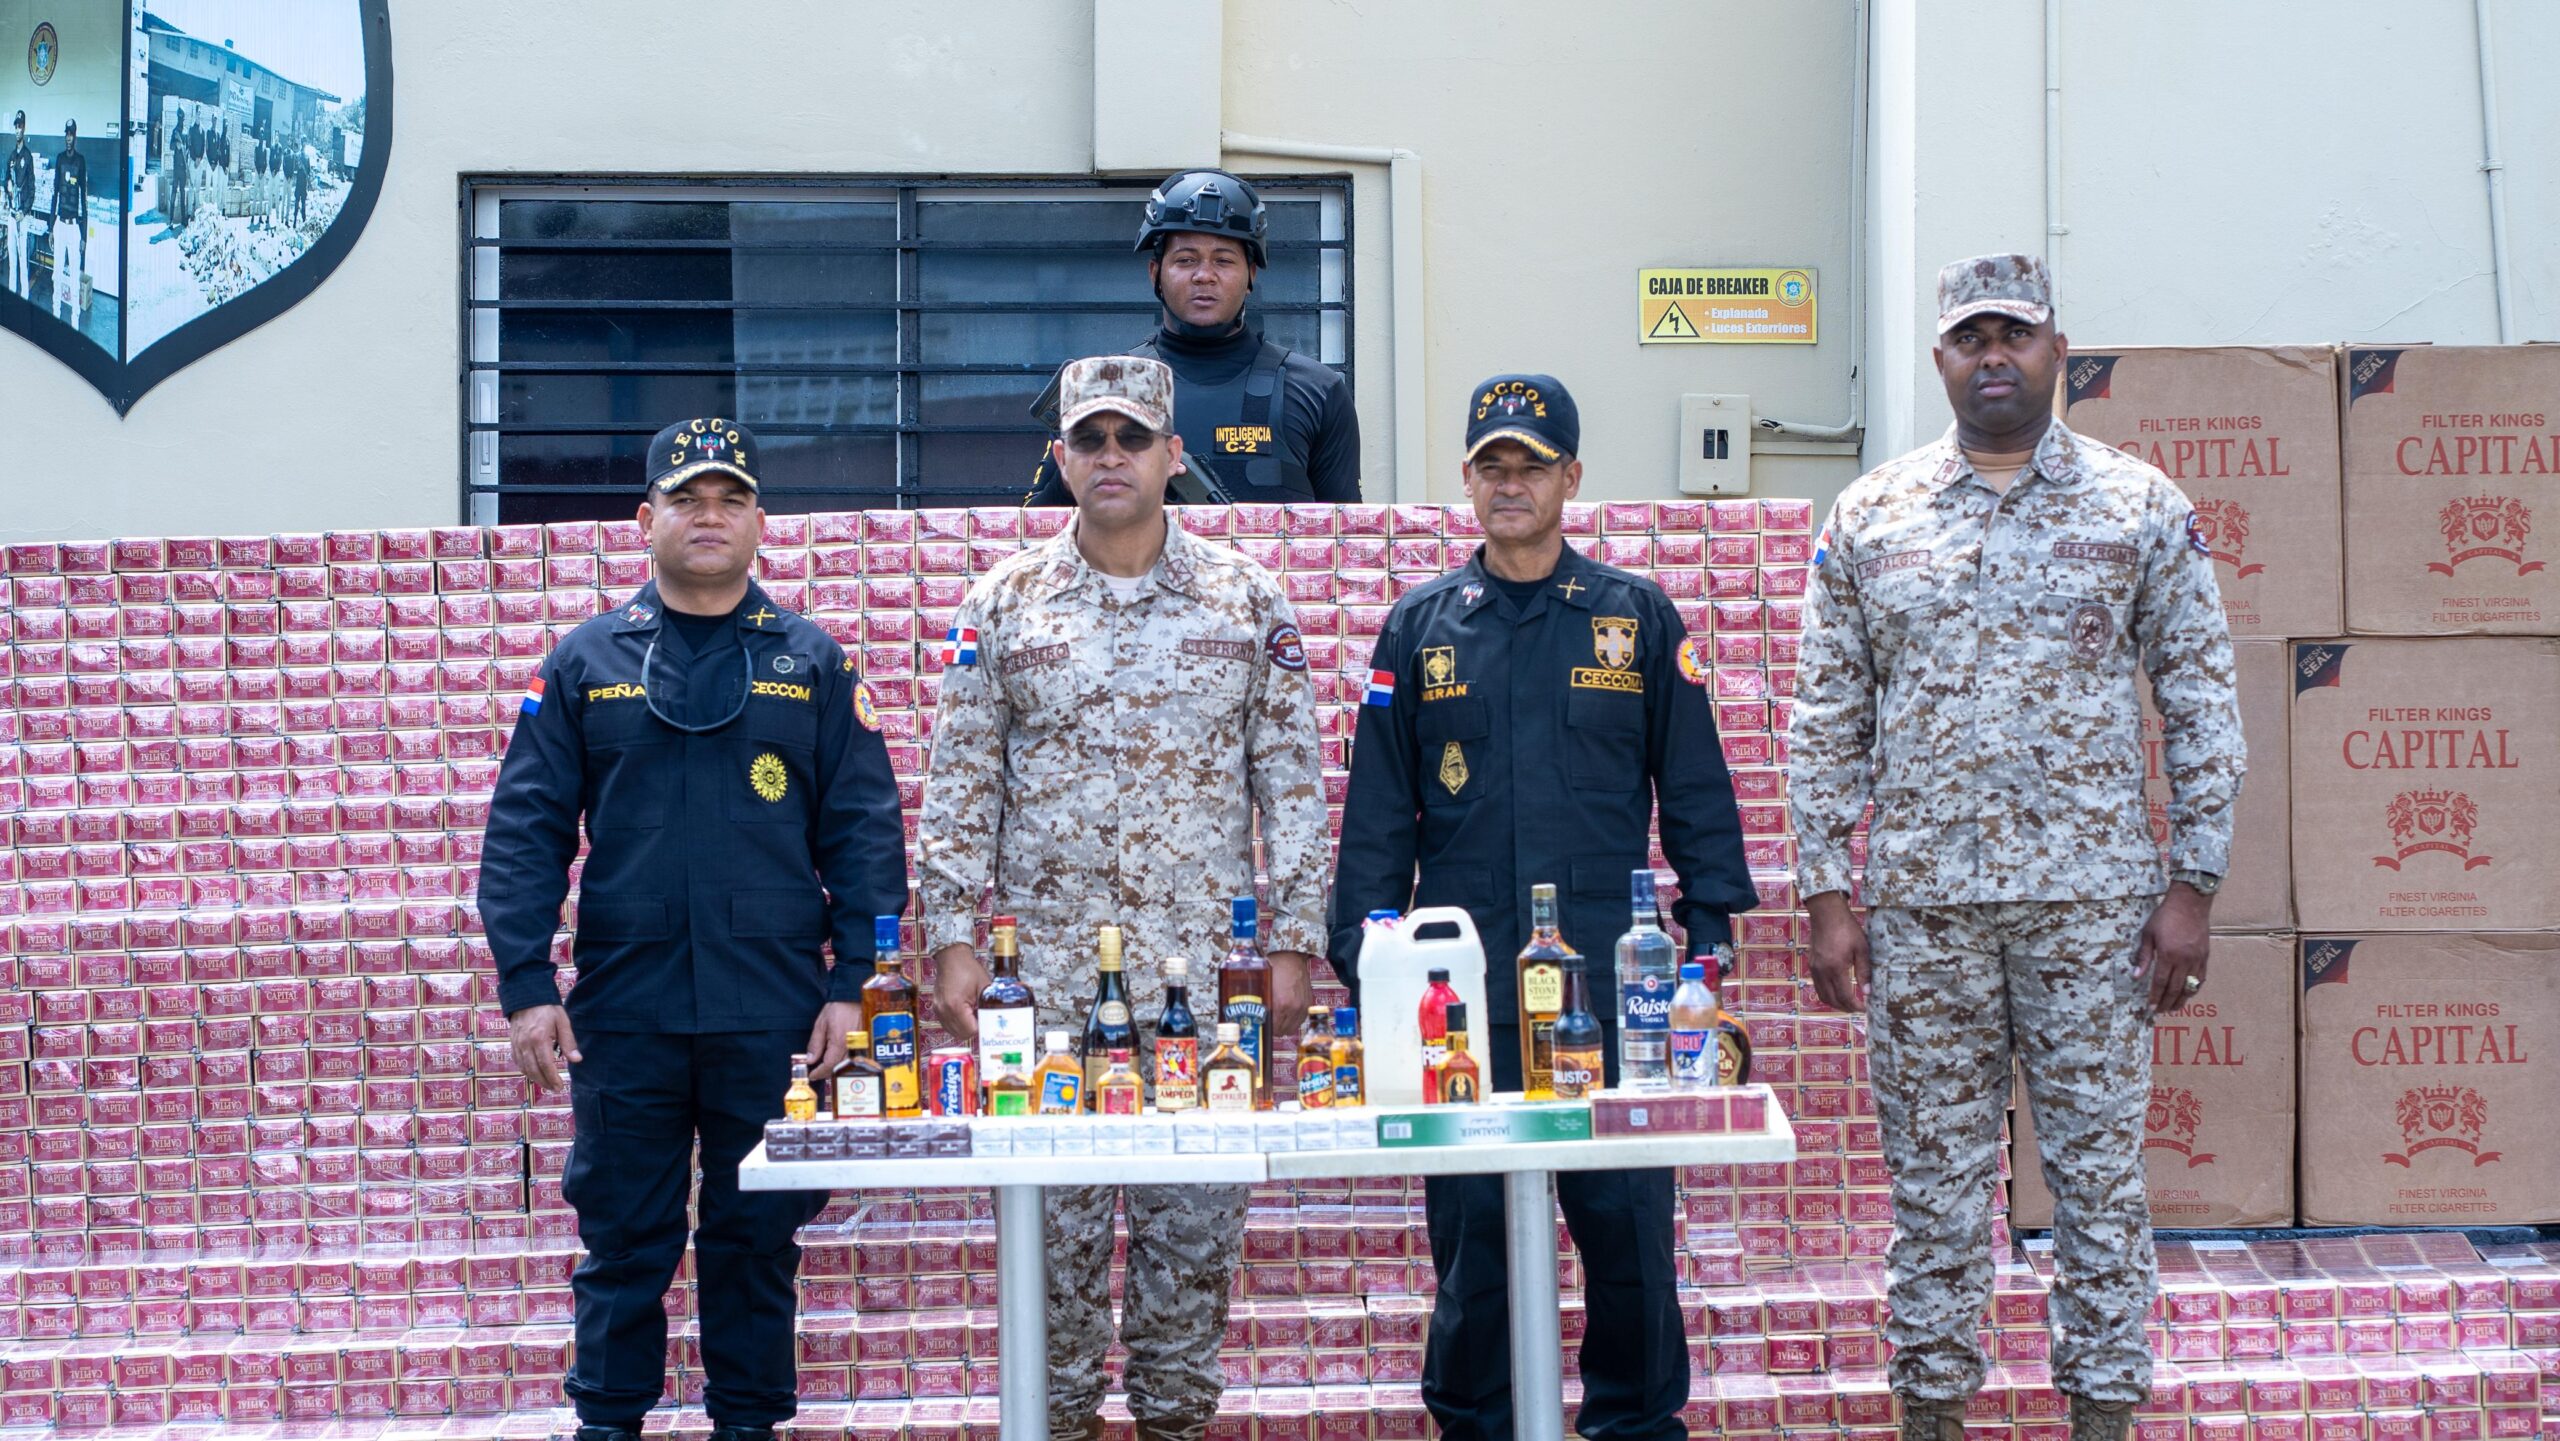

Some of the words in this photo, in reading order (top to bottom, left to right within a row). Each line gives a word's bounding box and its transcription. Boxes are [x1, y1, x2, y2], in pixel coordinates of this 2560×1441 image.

[1649, 277, 1683, 295] CAJA
[1686, 278, 1703, 295] DE
[1706, 277, 1769, 295] BREAKER
[1711, 307, 1768, 320] Explanada
[2352, 351, 2377, 376] FRESH
[2069, 357, 2094, 382] FRESH
[2357, 357, 2387, 385] SEAL
[2074, 362, 2104, 390] SEAL
[1477, 382, 1547, 420] CECCOM
[2139, 418, 2200, 433] FILTER
[2207, 415, 2262, 431] KINGS
[2422, 414, 2483, 428] FILTER
[2490, 413, 2545, 428] KINGS
[1216, 426, 1272, 442] INTELIGENCIA
[671, 418, 746, 468] CECCOM
[1225, 441, 1257, 453] C-2
[1719, 511, 1748, 520] CAPITAL
[283, 544, 312, 553] CAPITAL
[335, 542, 366, 551] CAPITAL
[123, 548, 152, 557] CAPITAL
[176, 551, 206, 560] CAPITAL
[1296, 549, 1325, 558] CAPITAL
[2057, 545, 2137, 564] CESFRONT
[874, 557, 905, 566] CAPITAL
[1865, 553, 1919, 576] HIDALGO
[611, 566, 640, 575] CAPITAL
[1770, 579, 1801, 588] CAPITAL
[1295, 584, 1325, 594] CAPITAL
[2442, 598, 2480, 608] FINEST
[2483, 597, 2532, 608] VIRGINIA
[2432, 612, 2469, 623] FILTER
[2472, 611, 2541, 622] CIGARETTES
[132, 618, 163, 627] CAPITAL
[2298, 645, 2325, 670] FRESH
[2303, 650, 2334, 679] SEAL
[1580, 671, 1640, 689] CECCOM
[589, 682, 647, 702] PEÑA
[751, 681, 811, 702] CECCOM
[874, 690, 904, 700] CAPITAL
[293, 714, 324, 723] CAPITAL
[2368, 708, 2430, 722] FILTER
[2436, 707, 2492, 721] KINGS
[30, 723, 61, 732] CAPITAL
[349, 744, 380, 753] CAPITAL
[455, 740, 486, 749] CAPITAL
[2342, 729, 2519, 770] CAPITAL
[1730, 746, 1761, 755] CAPITAL
[406, 776, 437, 785] CAPITAL
[1745, 814, 1777, 823] CAPITAL
[133, 820, 164, 829] CAPITAL
[187, 820, 219, 829] CAPITAL
[88, 890, 120, 899] CAPITAL
[2389, 892, 2427, 902] FINEST
[2429, 892, 2477, 902] VIRGINIA
[2379, 906, 2416, 917] FILTER
[2418, 906, 2487, 917] CIGARETTES
[1752, 927, 1784, 937] CAPITAL
[2307, 940, 2333, 965] FRESH
[253, 957, 284, 966] CAPITAL
[307, 955, 339, 964] CAPITAL
[2311, 945, 2343, 974] SEAL
[1528, 976, 1557, 985] BLACK
[1528, 986, 1557, 995] STONE
[211, 994, 244, 1004] CAPITAL
[2163, 1004, 2217, 1018] NGS
[2377, 1004, 2439, 1018] FILTER
[2444, 1003, 2500, 1017] KINGS
[99, 1035, 131, 1044] CAPITAL
[875, 1043, 913, 1057] BLUE
[2151, 1026, 2244, 1066] ITAL
[2351, 1024, 2528, 1067] CAPITAL
[1810, 1064, 1842, 1073] CAPITAL
[486, 1089, 518, 1098] CAPITAL
[945, 1064, 961, 1116] Prestige
[430, 1091, 463, 1100] CAPITAL
[1212, 1092, 1247, 1101] CHEVALIER
[44, 1107, 77, 1117] CAPITAL
[205, 1134, 237, 1144] CAPITAL
[316, 1163, 348, 1172] CAPITAL
[1801, 1169, 1834, 1178] CAPITAL
[481, 1194, 513, 1203] CAPITAL
[2153, 1189, 2200, 1200] VIRGINIA
[2398, 1189, 2437, 1199] FINEST
[2439, 1188, 2487, 1199] VIRGINIA
[1693, 1204, 1724, 1213] CAPITAL
[2149, 1204, 2210, 1214] IGARETTES
[2389, 1203, 2426, 1214] FILTER
[2428, 1202, 2497, 1213] CIGARETTES
[926, 1209, 958, 1218] CAPITAL
[1253, 1239, 1285, 1248] CAPITAL
[1365, 1237, 1397, 1246] CAPITAL
[1802, 1237, 1834, 1246] CAPITAL
[866, 1253, 898, 1263] CAPITAL
[921, 1251, 953, 1260] CAPITAL
[534, 1266, 566, 1276] CAPITAL
[255, 1277, 287, 1286] CAPITAL
[366, 1272, 398, 1281] CAPITAL
[33, 1282, 65, 1292] CAPITAL
[2522, 1288, 2554, 1297] CAPITAL
[2237, 1301, 2269, 1311] CAPITAL
[2292, 1298, 2327, 1308] CAPITAL
[1778, 1310, 1810, 1319] CAPITAL
[2005, 1305, 2039, 1315] CAPITAL
[351, 1359, 386, 1369] CAPITAL
[467, 1356, 500, 1366] CAPITAL
[1380, 1359, 1413, 1369] CAPITAL
[126, 1365, 158, 1375] CAPITAL
[295, 1362, 327, 1372] CAPITAL
[1267, 1367, 1299, 1376] CAPITAL
[12, 1369, 45, 1379] CAPITAL
[921, 1374, 953, 1383] CAPITAL
[864, 1380, 896, 1389] CAPITAL
[2317, 1391, 2352, 1401] CAPITAL
[1849, 1403, 1884, 1413] CAPITAL
[2025, 1400, 2059, 1410] CAPITAL
[1791, 1405, 1826, 1416] CAPITAL
[2437, 1420, 2472, 1430] CAPITAL
[2203, 1428, 2238, 1438] CAPITAL
